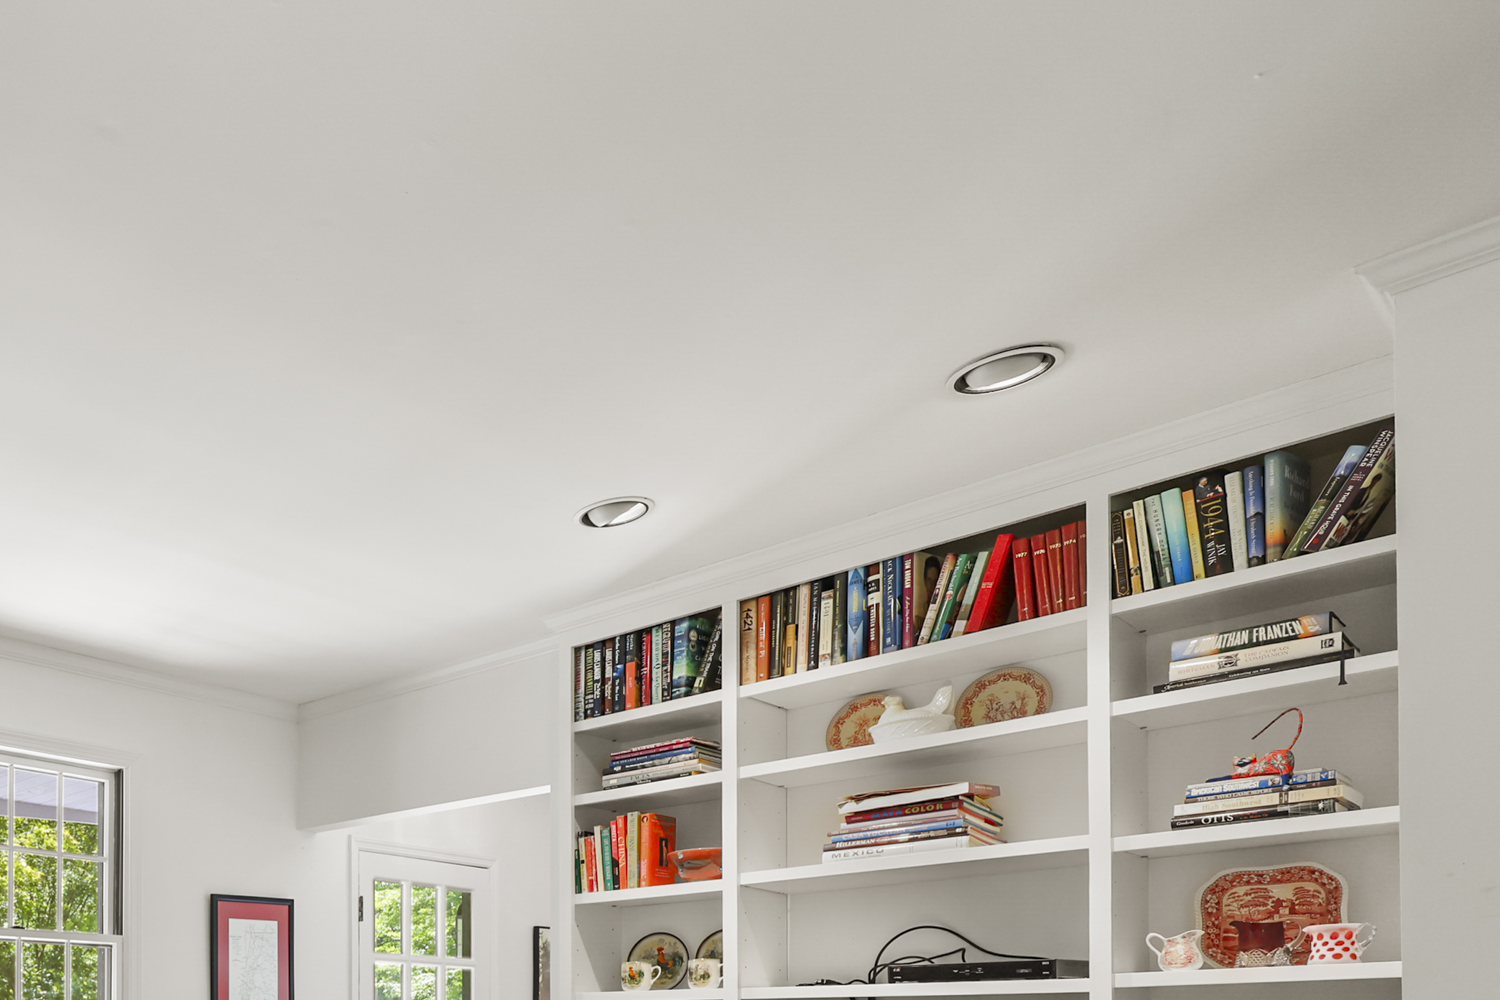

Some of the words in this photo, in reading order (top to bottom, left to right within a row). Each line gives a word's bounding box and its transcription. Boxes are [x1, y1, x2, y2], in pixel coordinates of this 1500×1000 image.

[1360, 430, 1388, 466] WINSPEAR
[1366, 430, 1393, 467] JACQUELINE
[1200, 498, 1225, 538] 1944
[1064, 538, 1076, 546] 1974
[1206, 541, 1216, 566] WINIK
[1216, 544, 1226, 556] JAY
[742, 608, 753, 632] 1421
[1252, 620, 1304, 642] FRANZEN
[871, 810, 902, 818] MAYA
[904, 803, 944, 814] COLOR
[618, 836, 626, 868] CHINA
[831, 848, 884, 859] MEXICO
[836, 838, 874, 848] HILLERMAN
